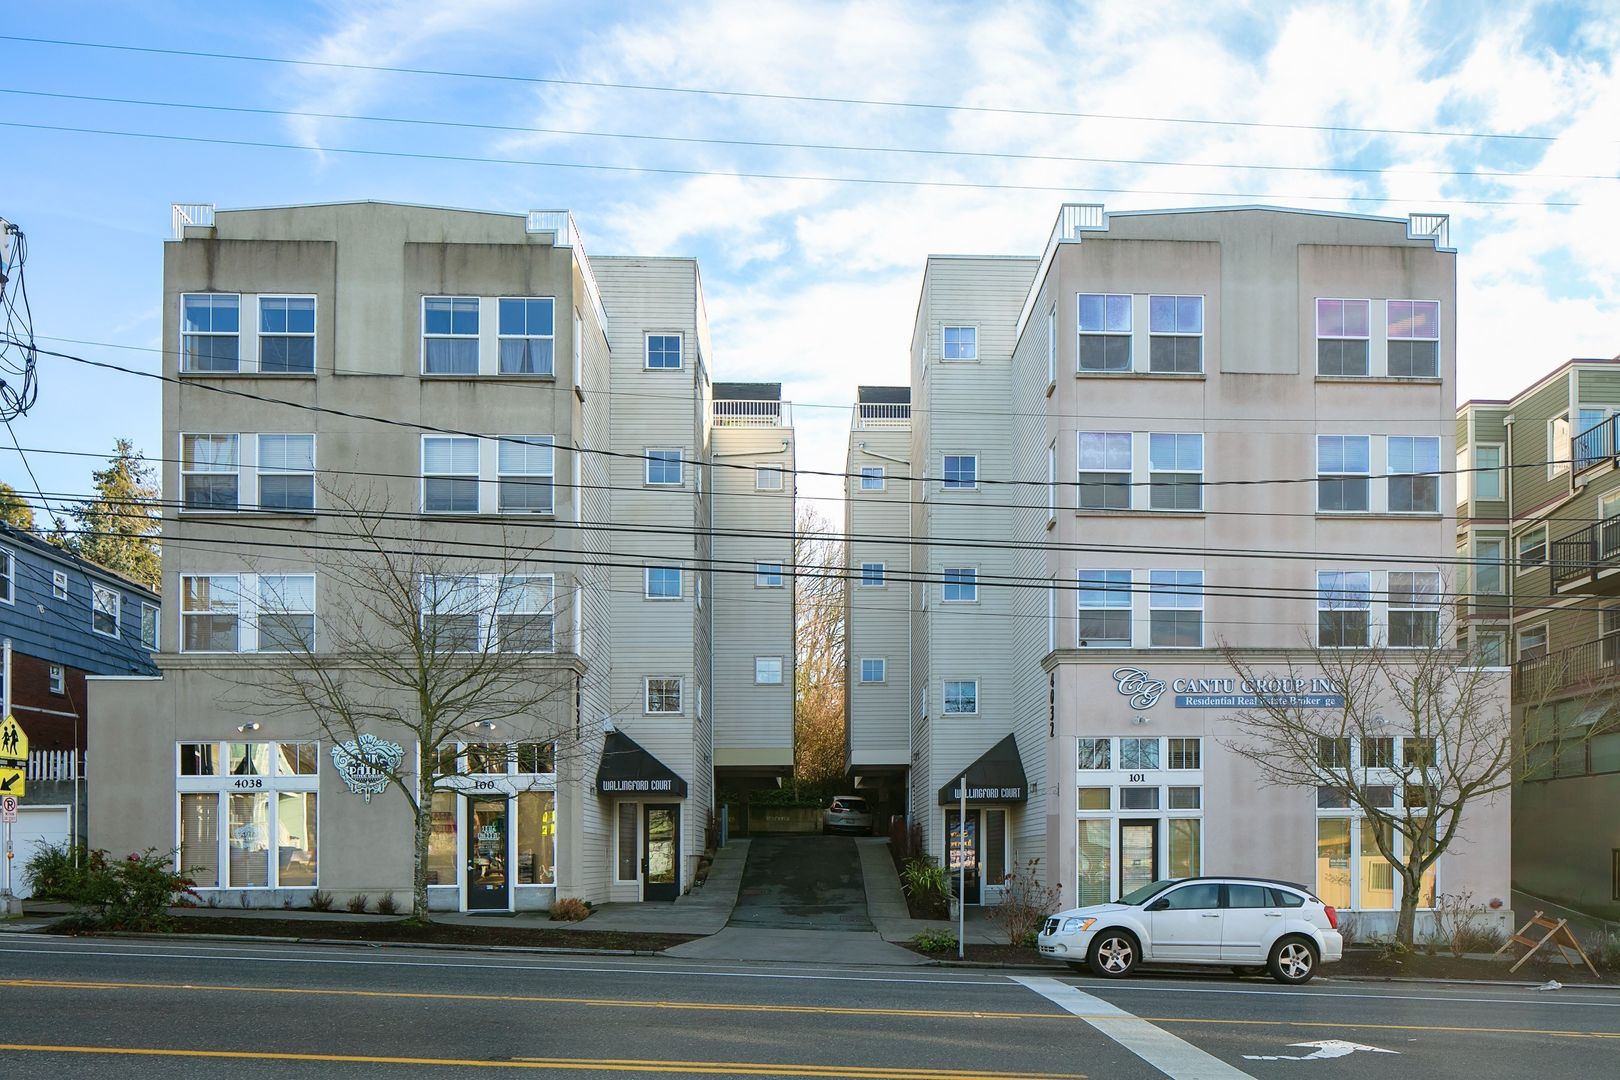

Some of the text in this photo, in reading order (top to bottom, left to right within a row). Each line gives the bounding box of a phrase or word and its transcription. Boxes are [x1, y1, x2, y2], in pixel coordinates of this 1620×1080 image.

[1173, 679, 1234, 693] CANTU
[1241, 679, 1305, 693] GROUP
[1186, 696, 1235, 706] Residential
[1237, 696, 1257, 706] Real
[1260, 696, 1287, 706] state
[1129, 774, 1146, 782] 101
[234, 779, 263, 788] 4038
[475, 780, 495, 790] 100
[602, 780, 672, 791] WALLINGFORD COURT
[954, 787, 1021, 799] WLLINGFORD COURT
